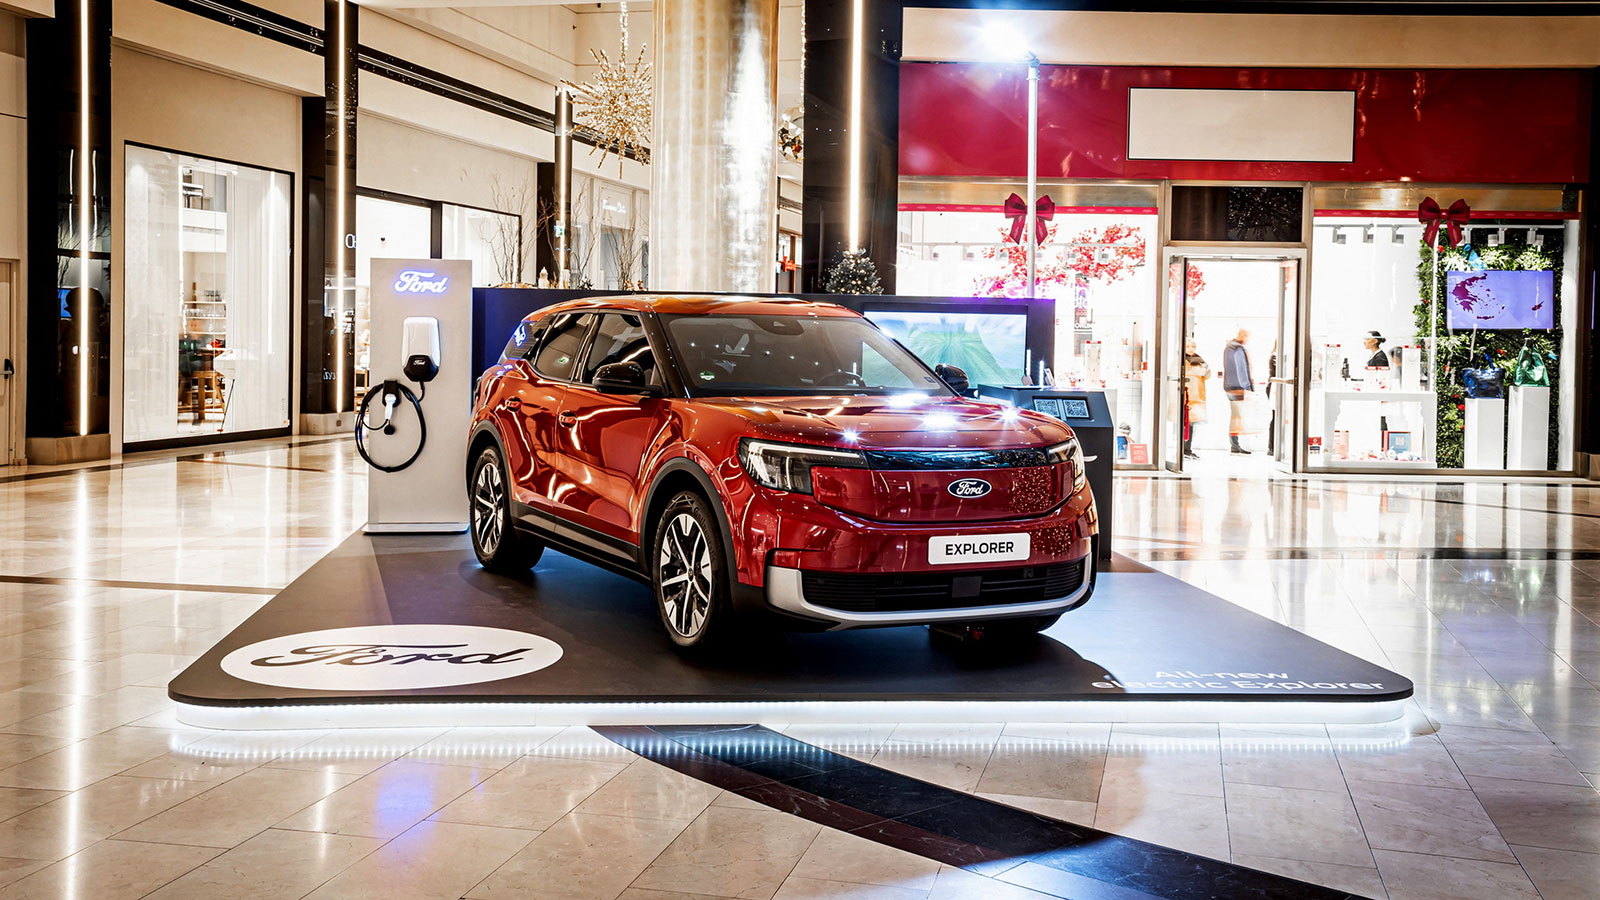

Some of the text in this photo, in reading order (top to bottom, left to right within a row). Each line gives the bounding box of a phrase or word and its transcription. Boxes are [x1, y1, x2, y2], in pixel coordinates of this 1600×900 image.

[394, 270, 448, 293] Ford
[956, 481, 984, 495] Ford
[945, 541, 1014, 555] EXPLORER
[250, 644, 534, 667] Ford
[1155, 671, 1288, 679] All-new
[1091, 680, 1385, 690] electric Explorer
